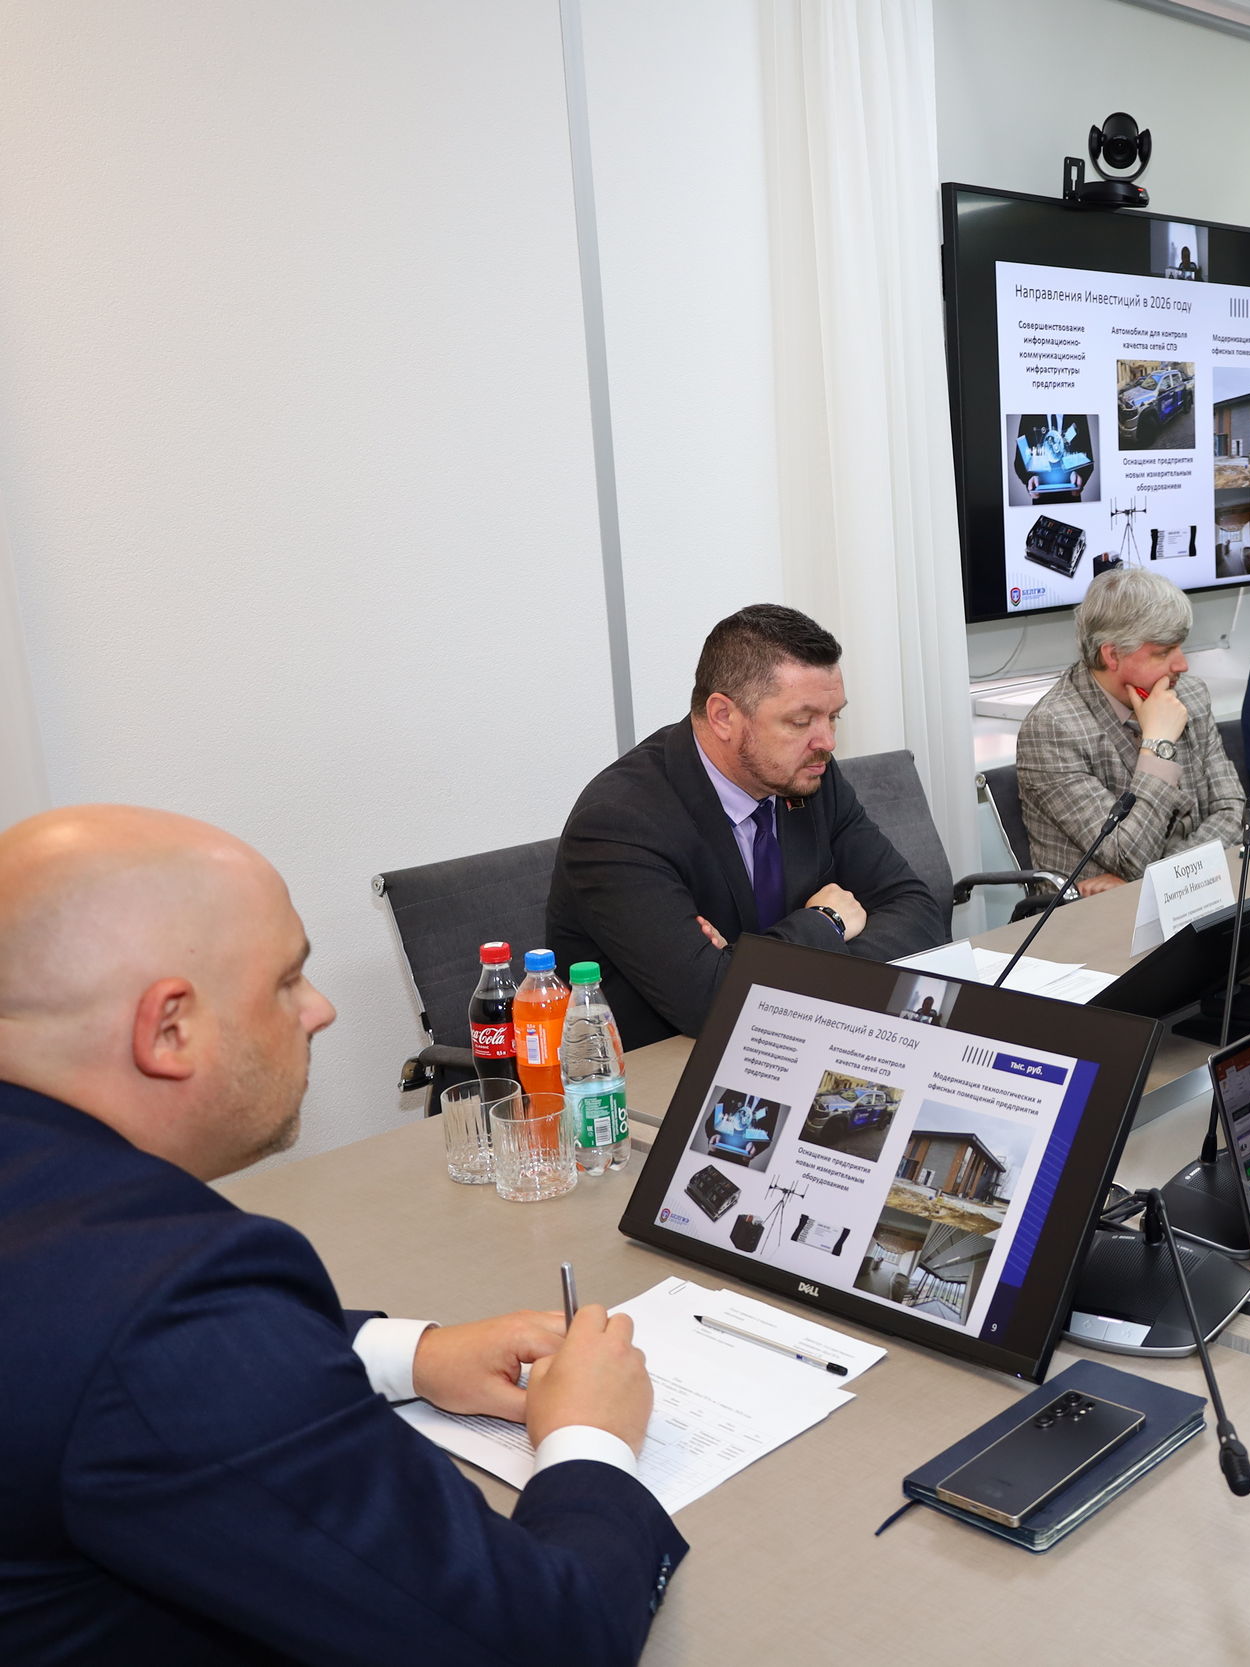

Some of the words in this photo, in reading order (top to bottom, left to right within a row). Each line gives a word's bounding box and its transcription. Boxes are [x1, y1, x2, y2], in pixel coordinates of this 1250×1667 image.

[1015, 284, 1082, 302] Направления
[1084, 290, 1140, 308] Инвестиций
[1143, 298, 1148, 308] в
[1150, 296, 1171, 310] 2026
[1173, 300, 1192, 314] году
[1018, 320, 1085, 332] Совершенствование
[1111, 326, 1148, 336] Автомобили
[1149, 330, 1160, 338] для
[1161, 331, 1188, 339] контроля
[1023, 335, 1081, 347] информационно-
[1123, 342, 1148, 350] качества
[1166, 343, 1178, 351] СПЭ
[1212, 334, 1250, 344] Модернизация
[1019, 352, 1086, 361] коммуникационной
[1026, 364, 1080, 376] инфраструктуры
[1032, 381, 1075, 389] предприятия
[1123, 458, 1156, 466] Оснащение
[1158, 457, 1193, 466] предприятия
[1136, 483, 1182, 492] оборудованием
[1173, 860, 1204, 879] Корзун
[1164, 885, 1189, 904] Дмитрий
[1189, 874, 1221, 893] Николаевич
[751, 1024, 806, 1044] Совершенствование
[758, 1001, 813, 1022] Направления
[814, 1014, 867, 1035] Инвестиций
[868, 1027, 873, 1037] в
[875, 1028, 898, 1043] 2026
[899, 1035, 921, 1050] году
[471, 1027, 507, 1045] ca-Cola
[750, 1036, 798, 1053] информационно-
[743, 1045, 799, 1065] коммуникационной
[828, 1044, 865, 1059] Автомобили
[864, 1053, 877, 1062] для
[877, 1056, 906, 1069] контроля
[744, 1056, 789, 1073] инфраструктуры
[835, 1058, 861, 1070] качества
[861, 1063, 878, 1074] сетей
[878, 1068, 891, 1077] СПЭ
[1010, 1061, 1025, 1071] тыс.
[1026, 1065, 1043, 1075] руб.
[744, 1067, 780, 1082] предприятия
[932, 1071, 981, 1090] Модернизация
[981, 1084, 1036, 1103] технологических
[928, 1083, 956, 1095] офисных
[956, 1090, 995, 1105] помещений
[996, 1100, 1039, 1116] предприятия
[797, 1147, 831, 1162] Оснащение
[831, 1158, 871, 1174] предприятия
[795, 1159, 816, 1169] новым
[816, 1165, 865, 1184] измерительным
[802, 1172, 850, 1191] оборудованием
[798, 1282, 819, 1297] DELL
[991, 1323, 998, 1332] 9
